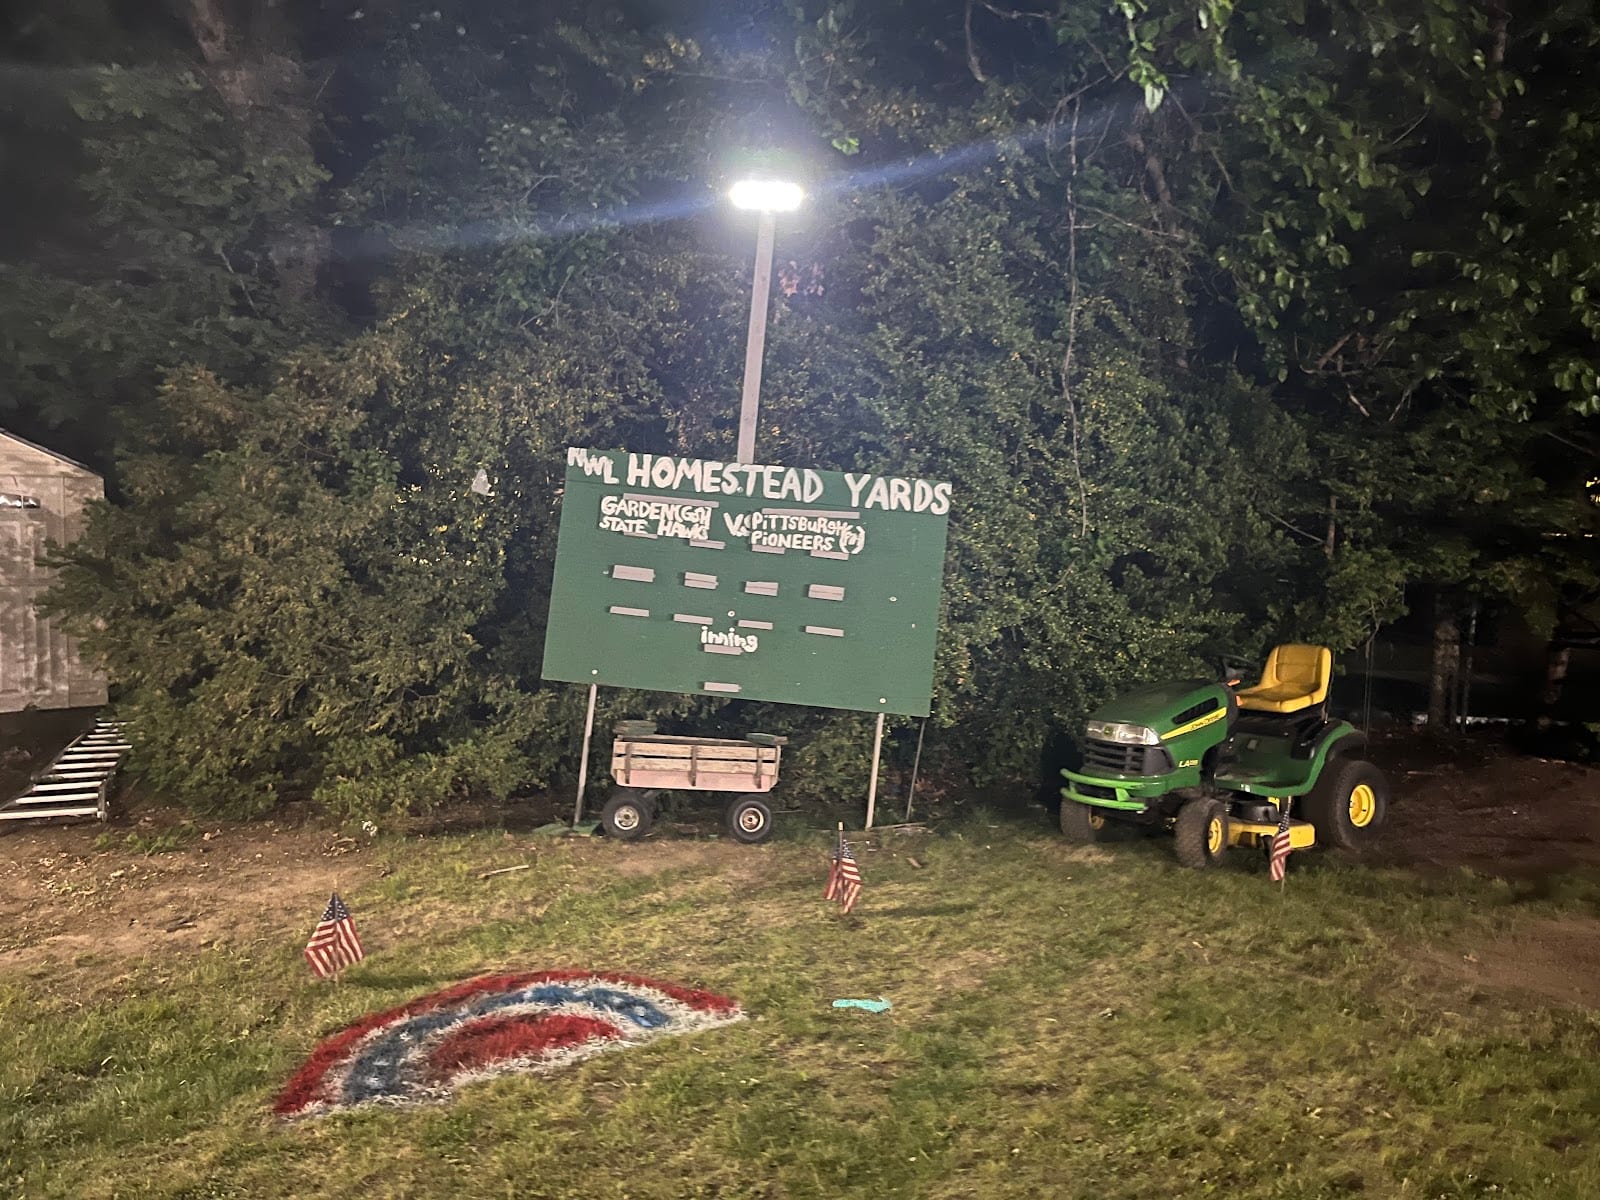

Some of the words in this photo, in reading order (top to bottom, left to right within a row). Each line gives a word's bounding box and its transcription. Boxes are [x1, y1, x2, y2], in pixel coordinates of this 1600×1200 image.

[627, 453, 824, 502] HOMESTEAD
[844, 473, 953, 515] YARDS
[598, 516, 649, 534] STATE
[701, 625, 759, 653] inning
